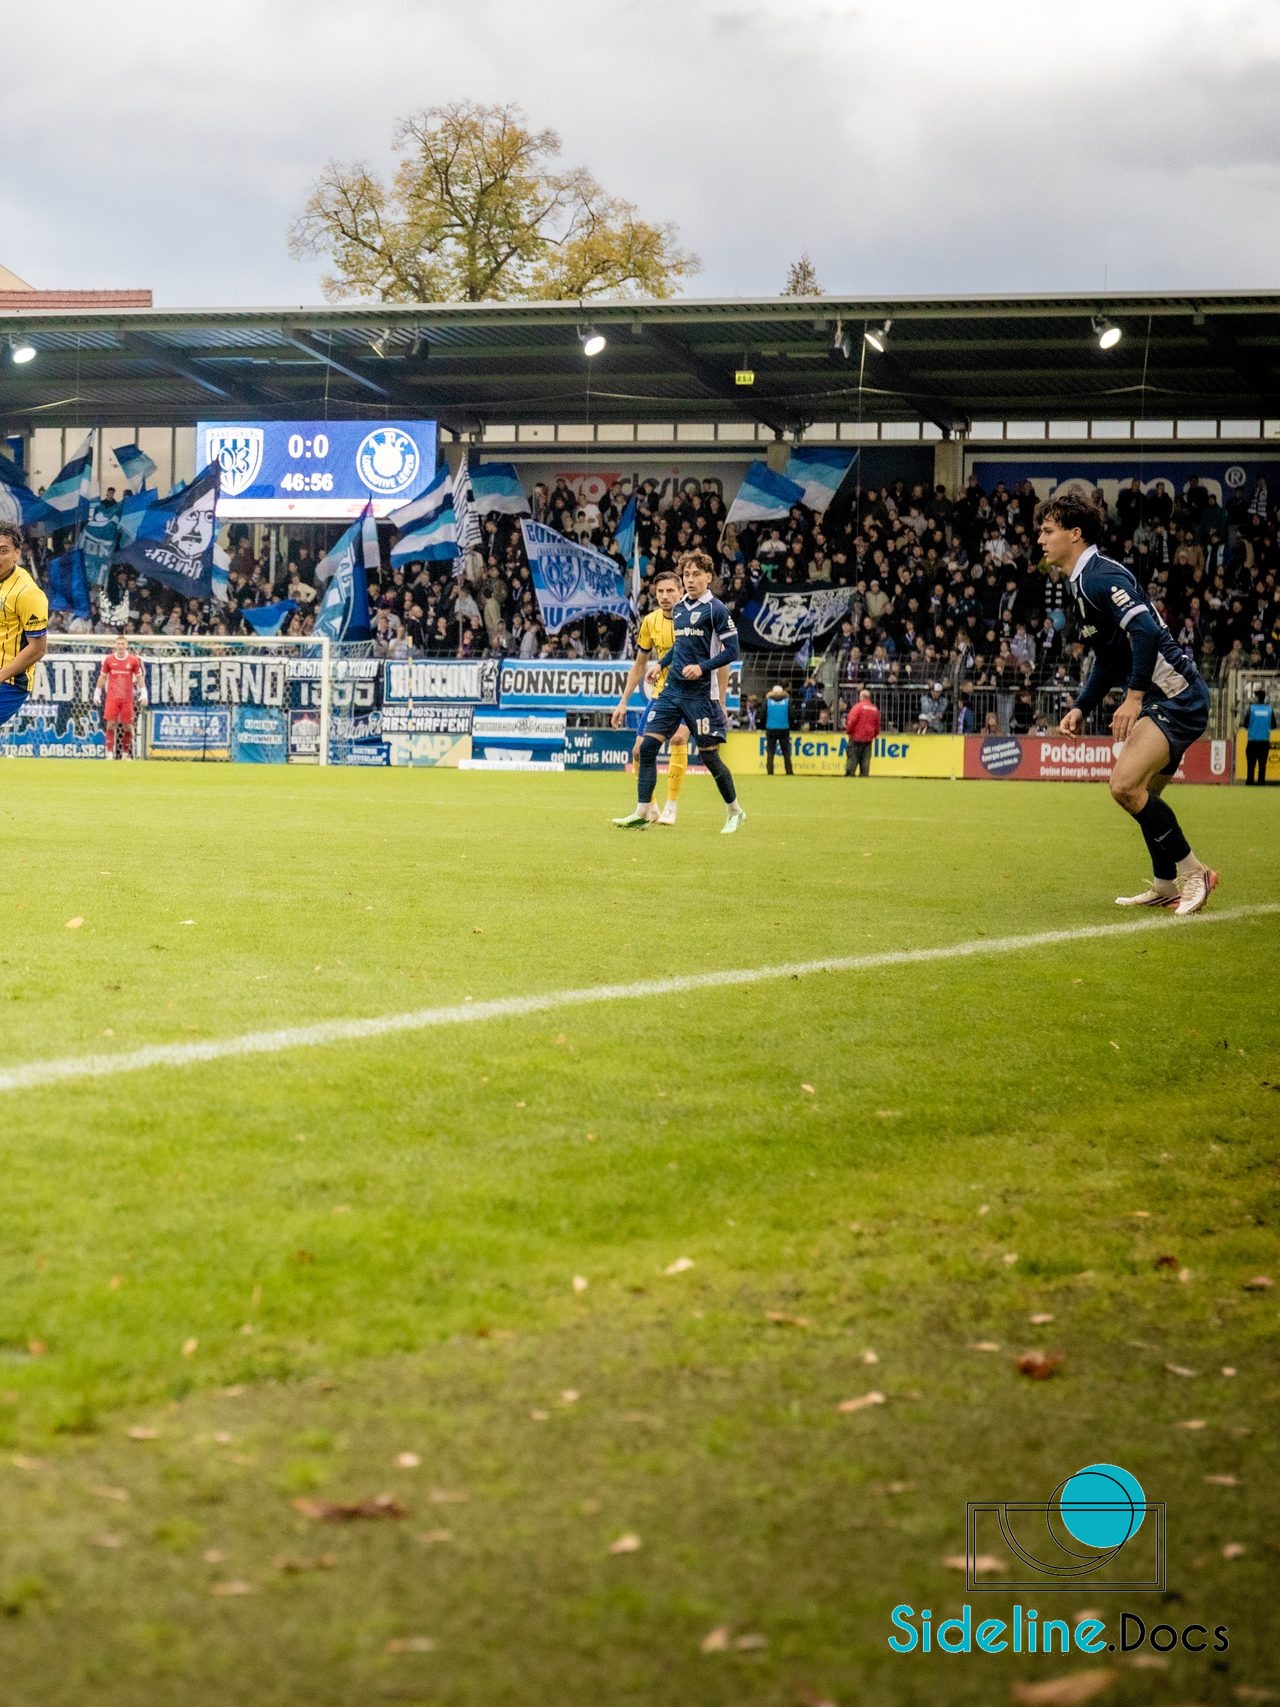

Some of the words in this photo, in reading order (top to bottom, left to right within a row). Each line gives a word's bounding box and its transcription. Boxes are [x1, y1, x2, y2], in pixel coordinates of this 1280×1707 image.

[288, 434, 329, 458] 0:0
[280, 473, 334, 491] 46:56
[150, 662, 286, 706] INFERNO
[501, 670, 628, 696] CONNECTION
[160, 715, 220, 727] ALERTA
[382, 718, 470, 732] ABSCHAFFEN!
[695, 717, 710, 736] 18
[575, 733, 593, 747] wir
[759, 737, 910, 758] Rifen-Mller
[39, 744, 106, 757] BABELSBE
[583, 750, 600, 763] ins
[601, 750, 629, 763] KINO
[1040, 742, 1111, 763] Potsdam
[1040, 766, 1061, 776] Deine
[1061, 766, 1090, 778] Energie.
[1091, 766, 1112, 777] Deine
